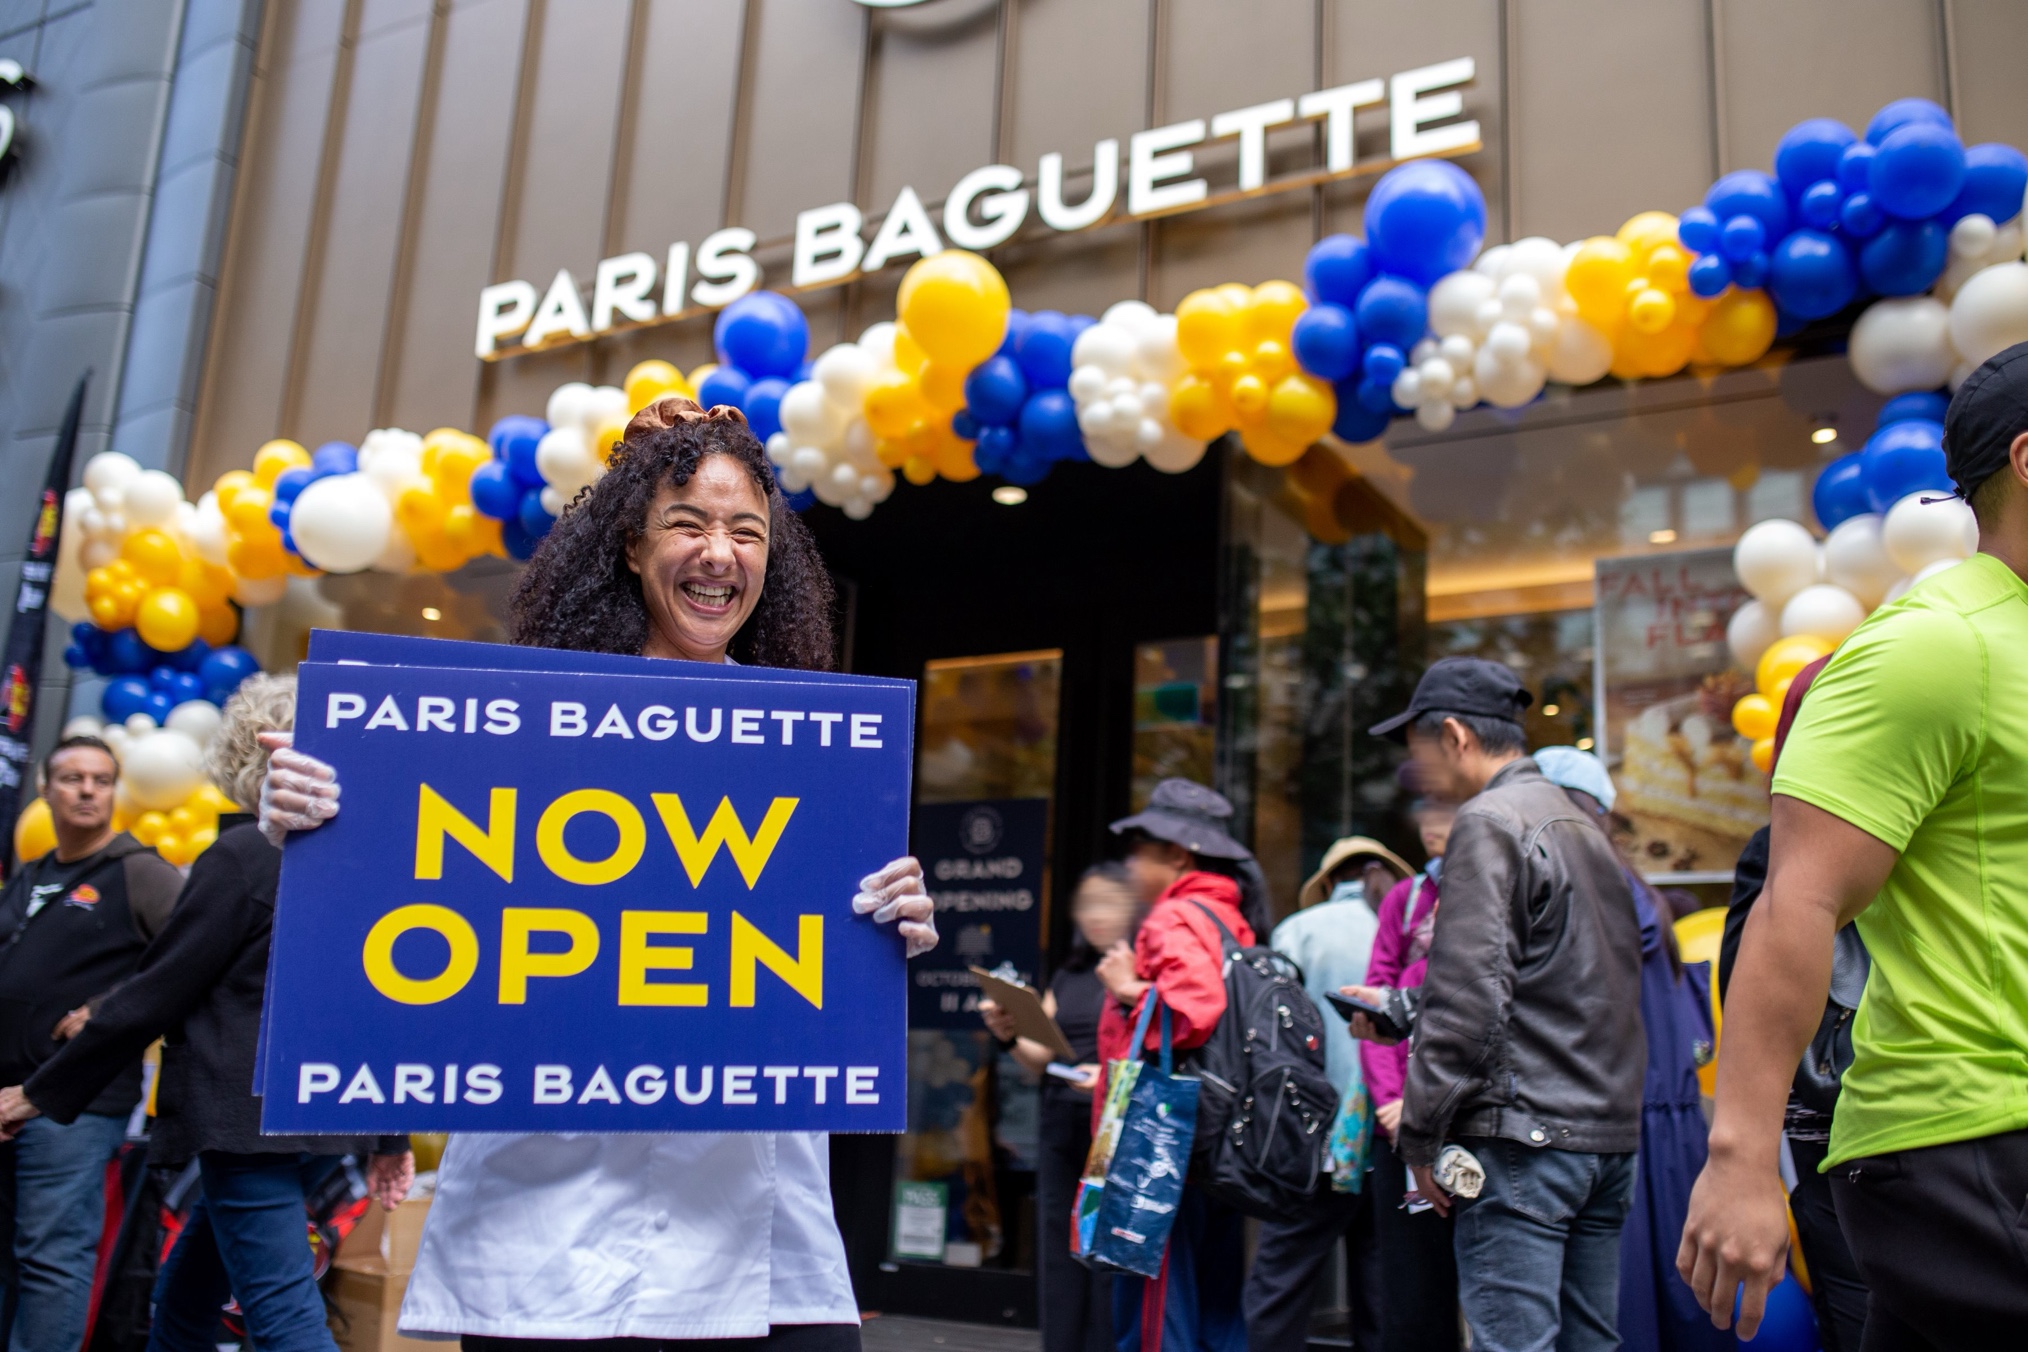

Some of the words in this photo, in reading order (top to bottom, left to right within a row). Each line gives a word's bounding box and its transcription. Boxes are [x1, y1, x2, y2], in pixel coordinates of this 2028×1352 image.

[476, 227, 759, 360] PARIS
[792, 56, 1481, 288] BAGUETTE
[327, 693, 521, 735] PARIS
[550, 701, 883, 749] BAGUETTE
[414, 783, 800, 890] NOW
[935, 857, 1023, 881] GRAND
[362, 903, 824, 1009] OPEN
[298, 1063, 503, 1104] PARIS
[533, 1064, 880, 1105] BAGUETTE
